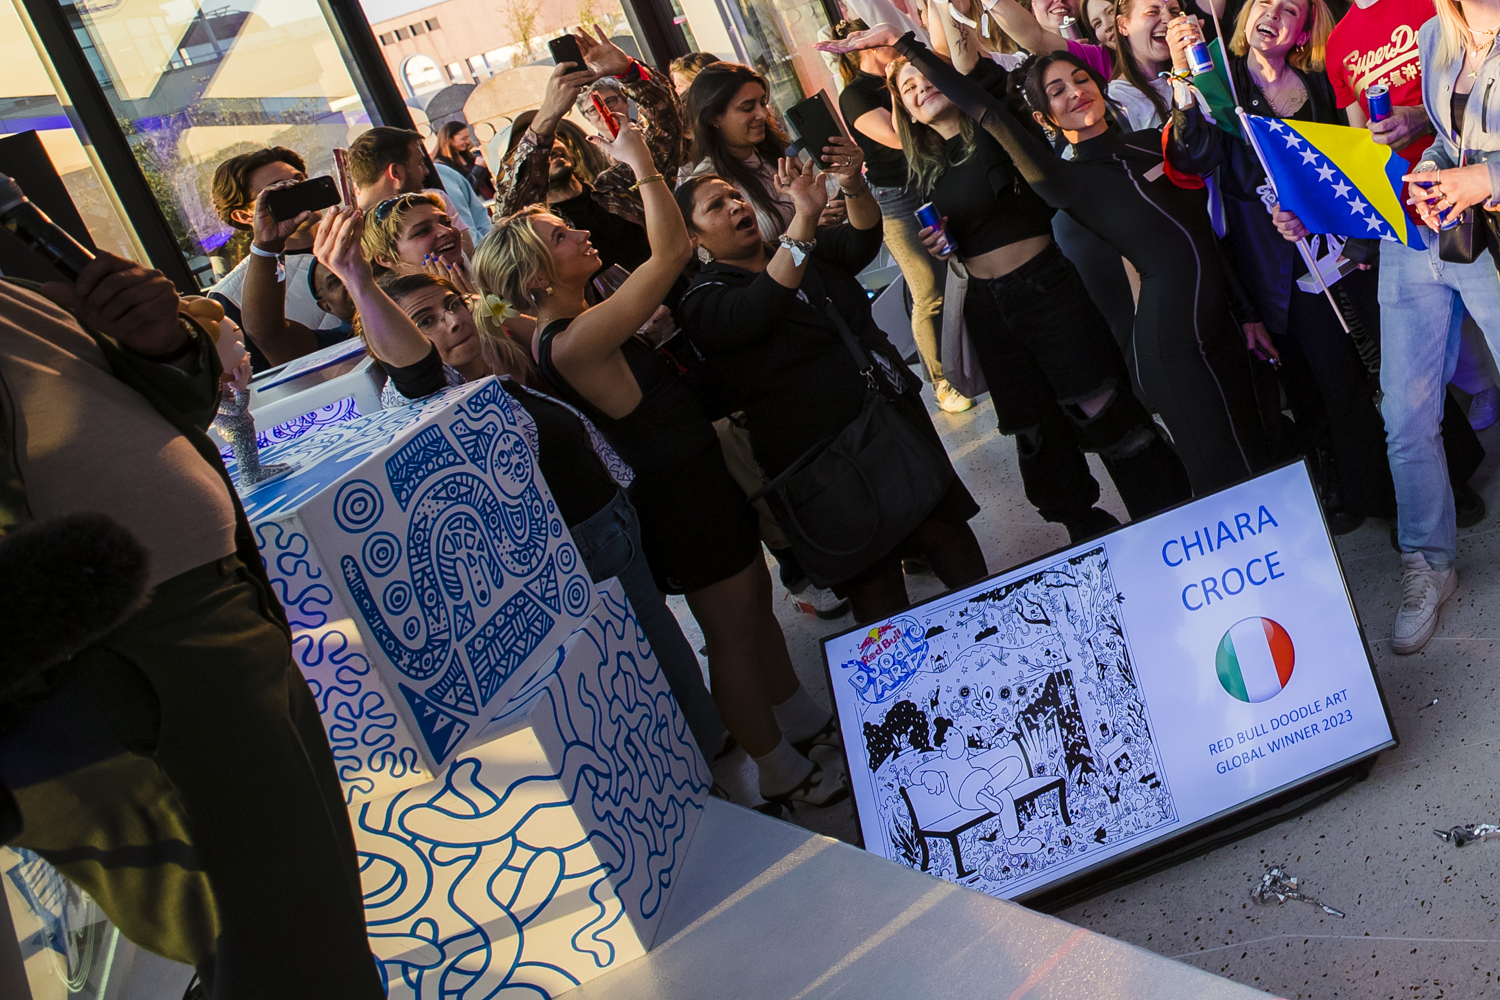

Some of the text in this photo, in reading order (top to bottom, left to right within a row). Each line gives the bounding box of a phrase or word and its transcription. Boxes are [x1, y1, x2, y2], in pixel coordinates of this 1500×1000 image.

[1161, 504, 1279, 567] CHIARA
[1181, 550, 1285, 611] CROCE
[861, 628, 902, 666] Red Bull
[1208, 688, 1348, 756] RED BULL DOODLE ART
[1216, 709, 1353, 774] GLOBAL WINNER 2023
